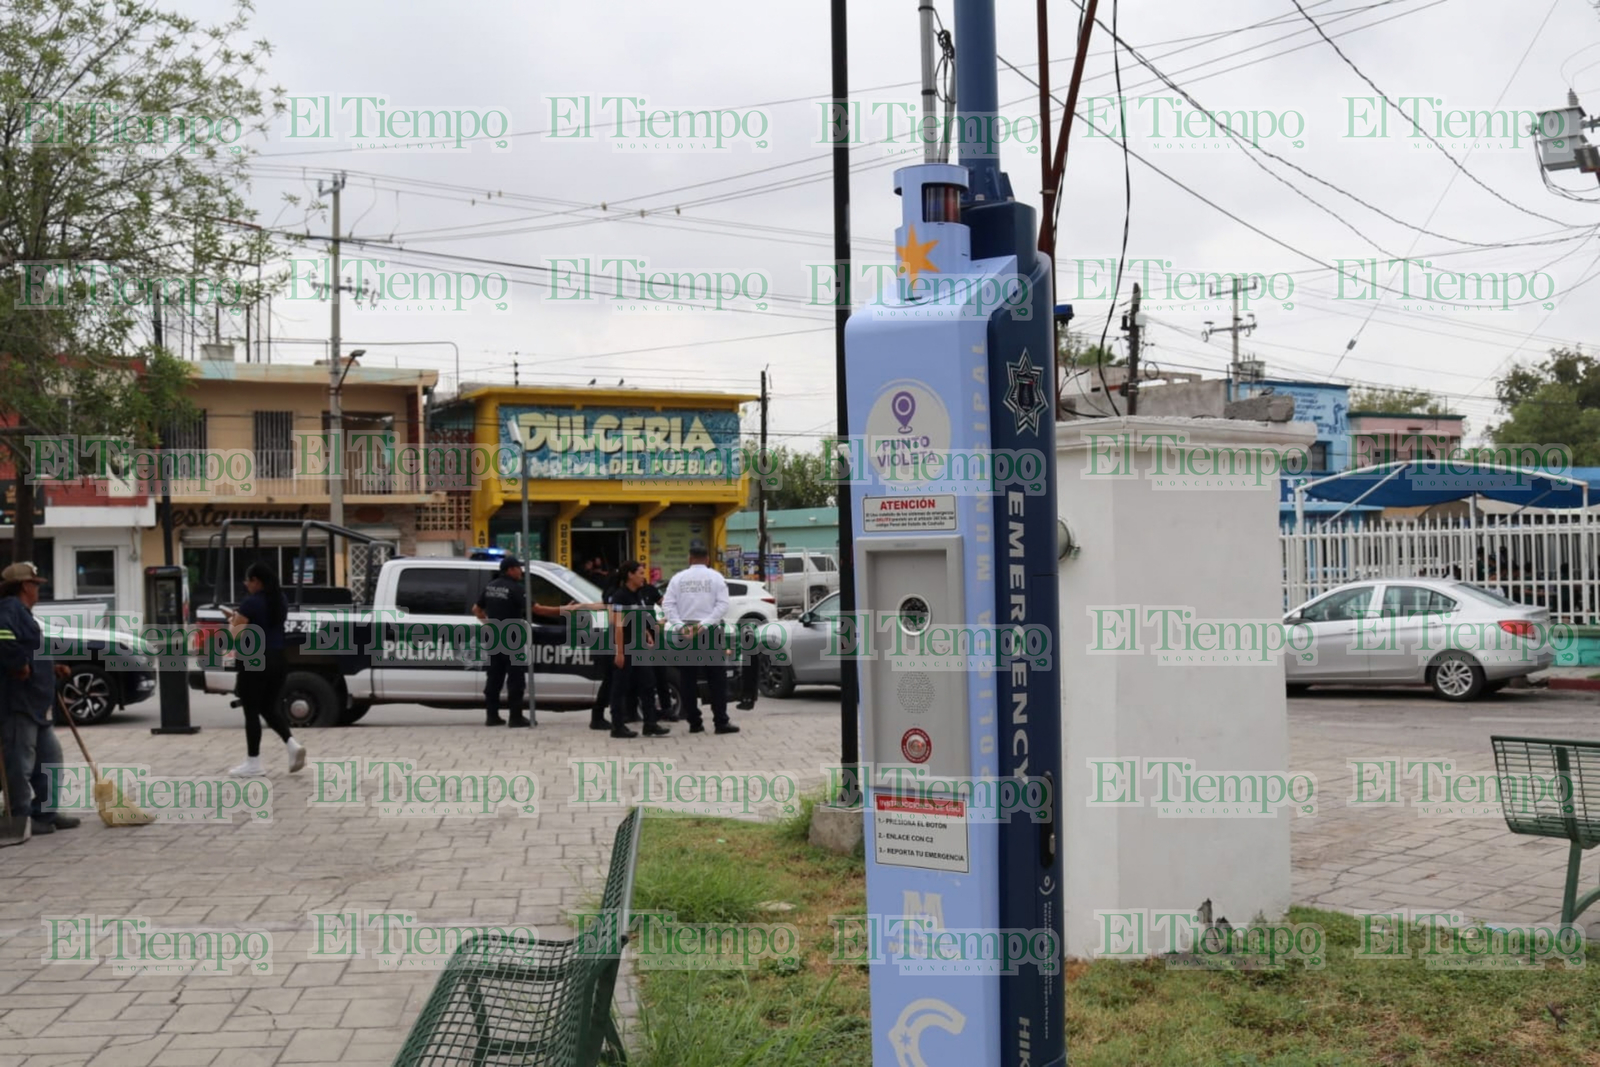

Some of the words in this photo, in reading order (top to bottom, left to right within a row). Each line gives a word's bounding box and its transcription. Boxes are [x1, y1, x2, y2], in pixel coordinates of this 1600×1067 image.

[517, 412, 716, 453] DULCERIA
[882, 436, 930, 451] PUNTO
[877, 449, 938, 467] VIOLETA
[610, 458, 645, 475] DEL
[647, 459, 722, 475] PUEBLO
[880, 498, 935, 510] ATENCIÓN
[283, 620, 322, 633] SP-267
[1008, 491, 1029, 784] EMERGENCY
[383, 638, 454, 661] POLICÍA
[886, 833, 909, 842] ENLACE
[911, 835, 925, 843] CON
[887, 848, 915, 857] REPORTA
[925, 851, 964, 862] EMERGENCIA
